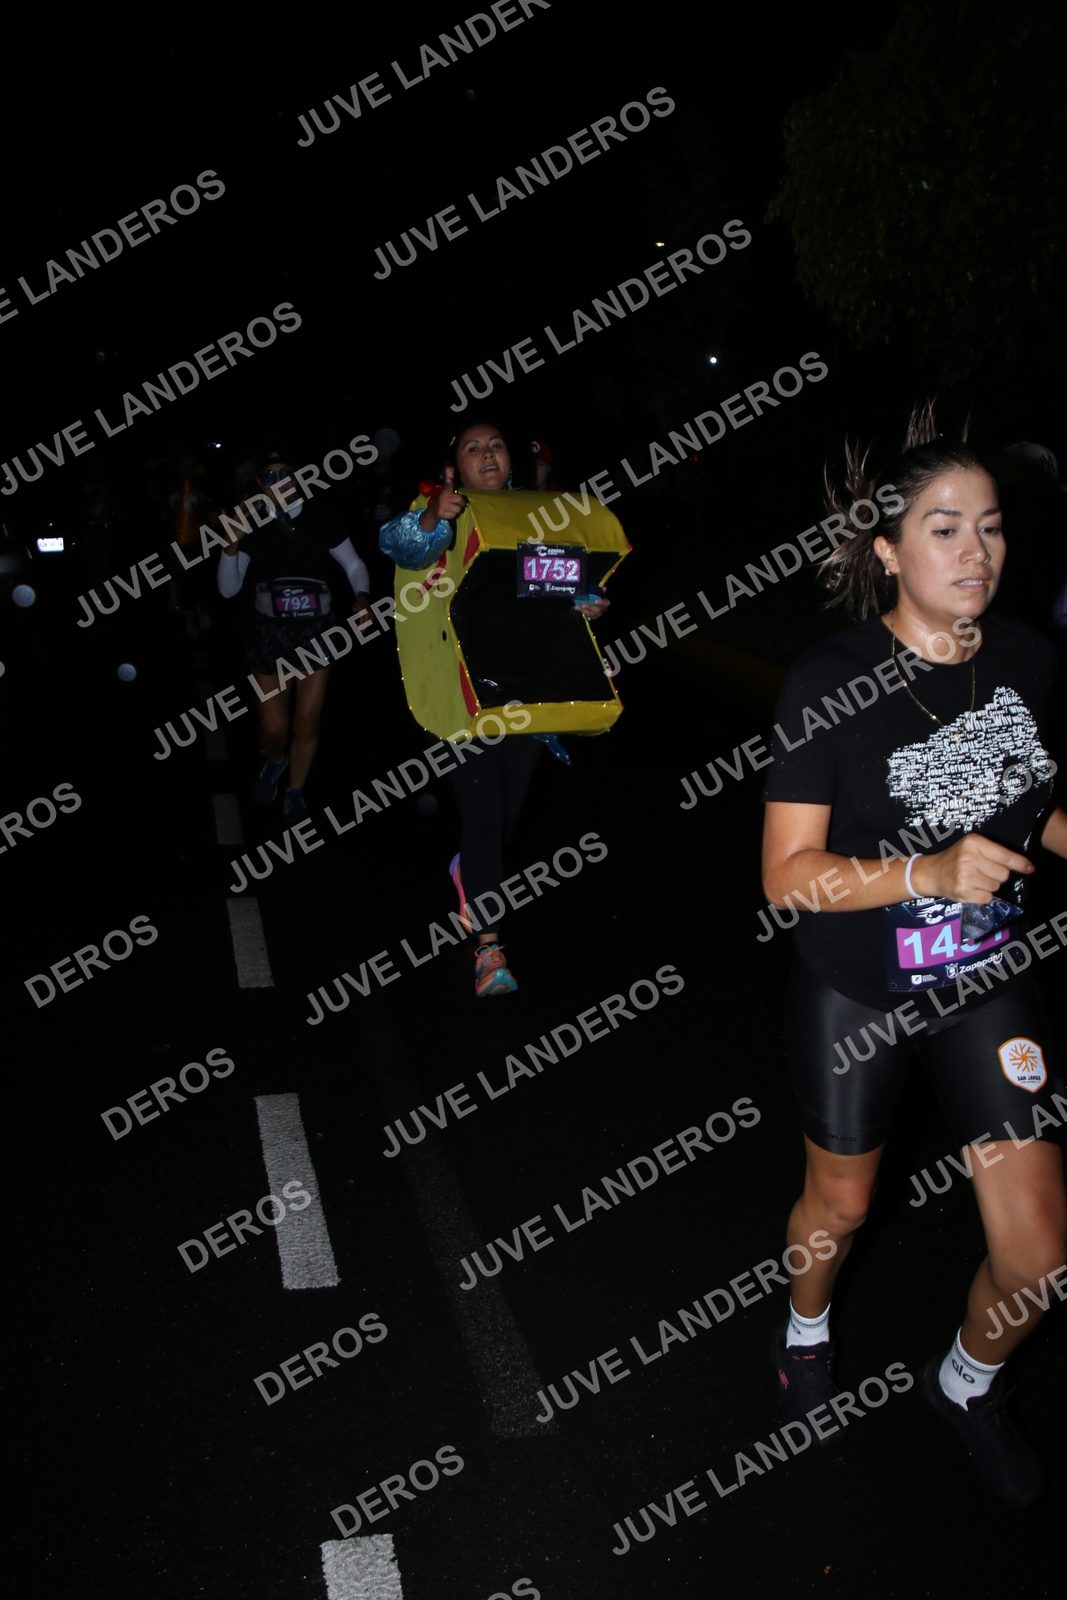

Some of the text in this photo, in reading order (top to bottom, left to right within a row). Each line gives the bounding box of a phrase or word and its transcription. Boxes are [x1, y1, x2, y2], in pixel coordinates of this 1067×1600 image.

[527, 558, 579, 581] 1752
[282, 595, 310, 612] 792
[903, 924, 1003, 965] 14
[951, 1358, 975, 1384] alo
